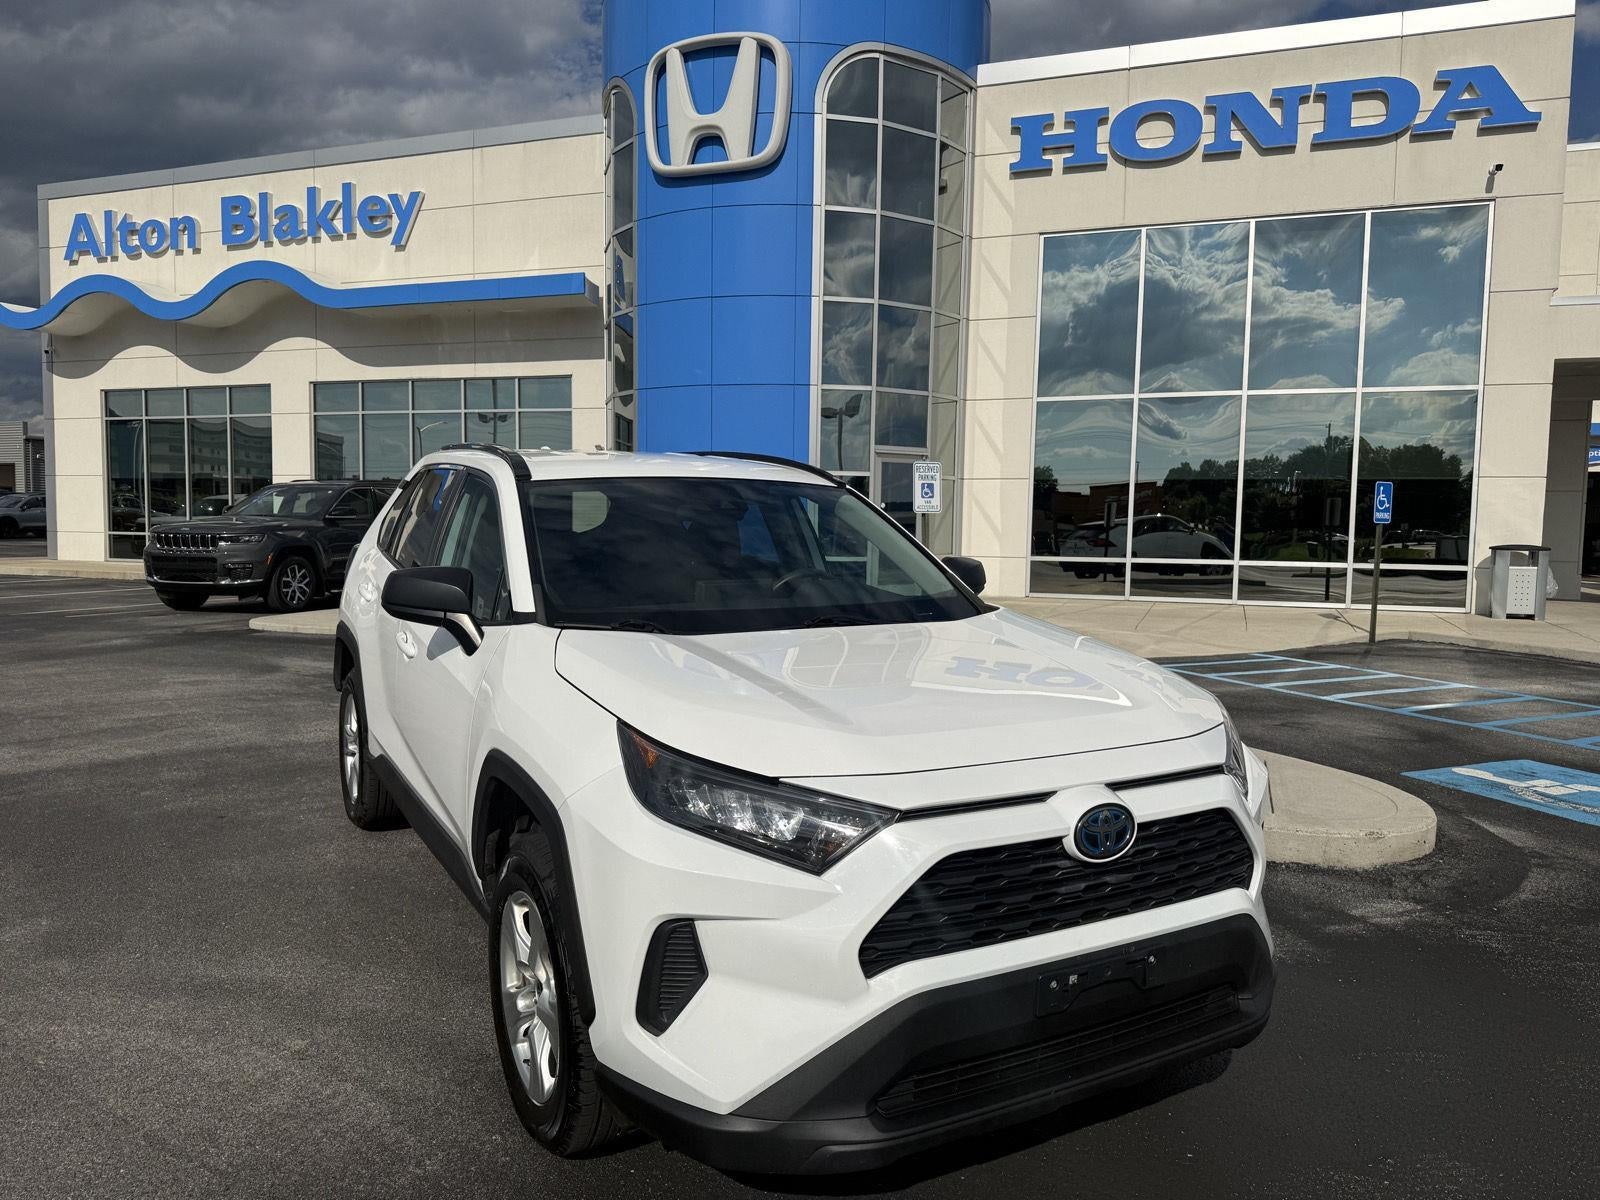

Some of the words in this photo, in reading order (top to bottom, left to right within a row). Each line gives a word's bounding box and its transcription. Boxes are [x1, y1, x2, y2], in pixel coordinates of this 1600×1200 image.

[1009, 65, 1542, 174] HONDA
[64, 209, 201, 263] Alton
[220, 181, 425, 252] Blakley
[915, 465, 939, 473] RESERVED
[917, 473, 937, 481] PARKING
